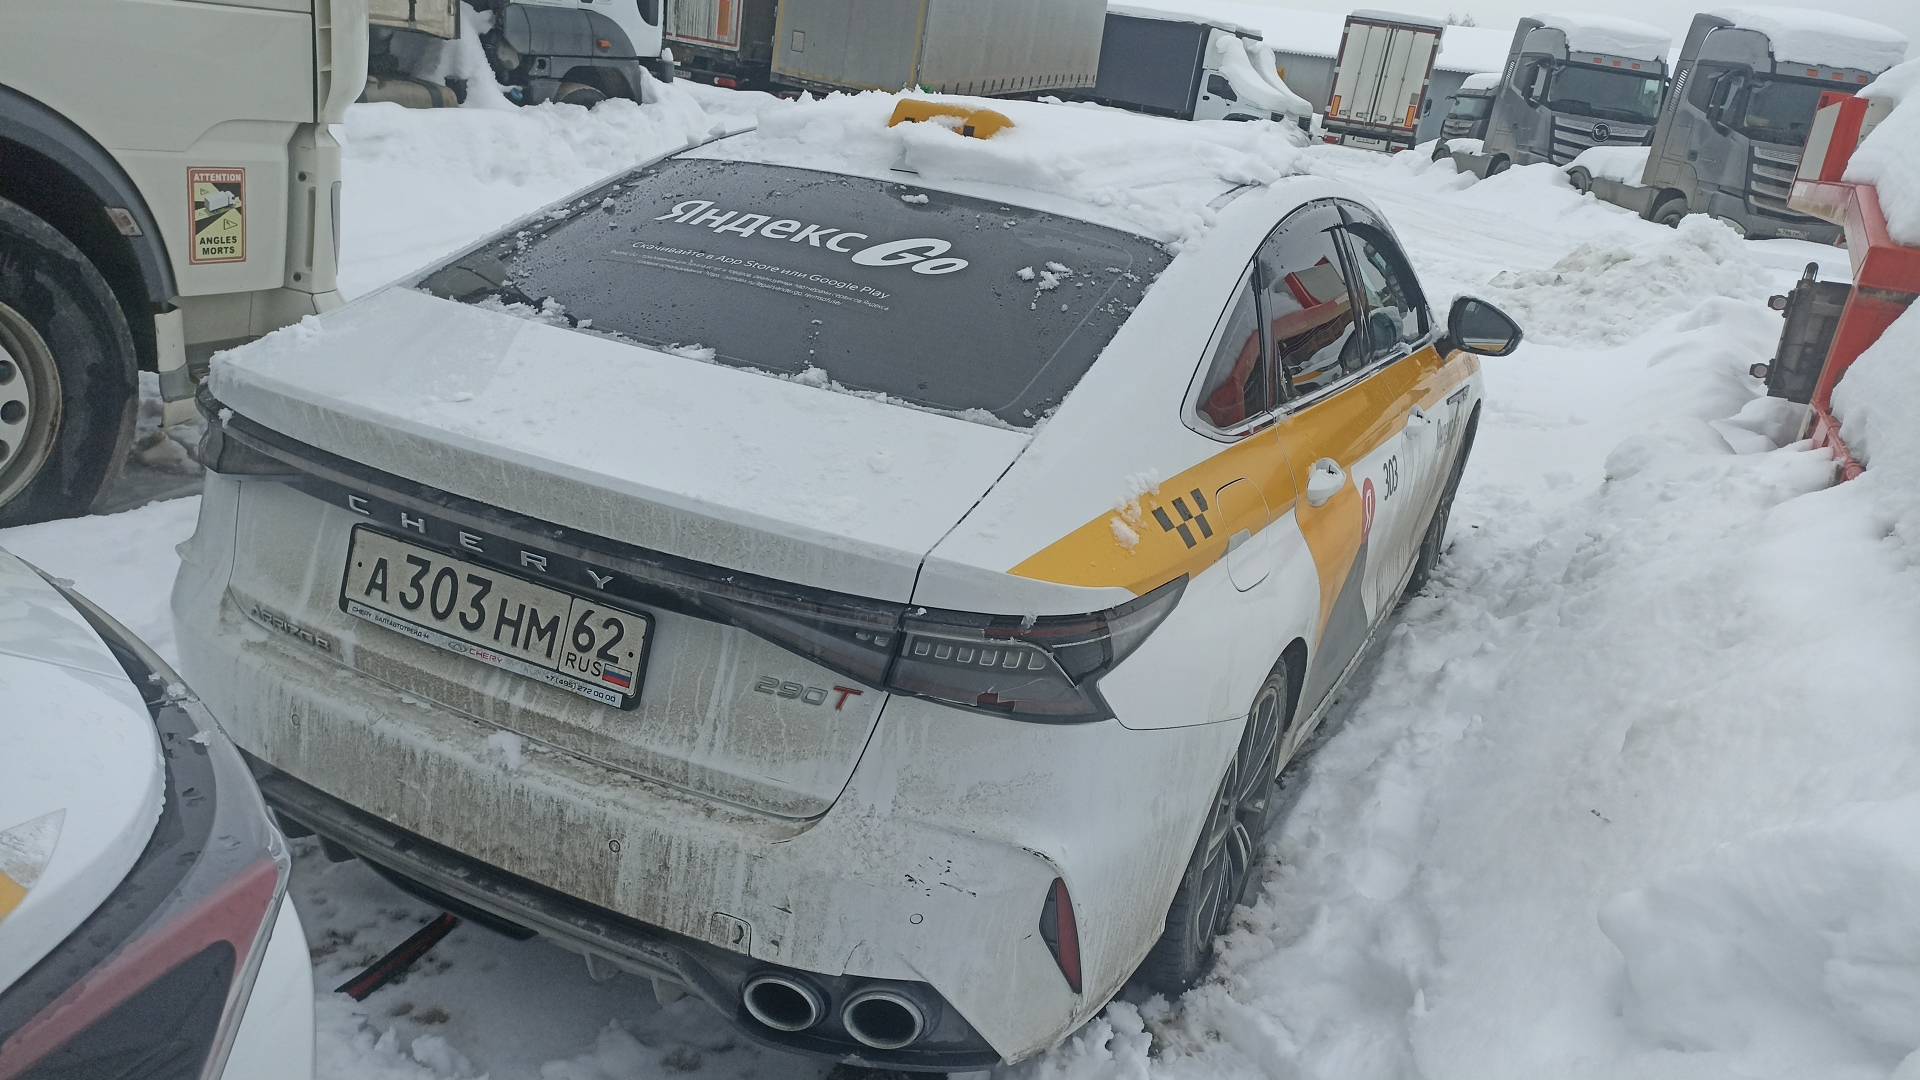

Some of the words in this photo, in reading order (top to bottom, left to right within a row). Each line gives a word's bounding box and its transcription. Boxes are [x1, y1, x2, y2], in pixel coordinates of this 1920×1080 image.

[193, 173, 242, 182] ATTENTION
[199, 235, 238, 245] ANGLES
[202, 245, 236, 255] MORTS
[654, 200, 868, 253] Яндекс
[851, 237, 969, 275] Go
[632, 241, 705, 258] Скачивайте
[715, 255, 743, 265] App
[743, 260, 779, 272] Store
[780, 269, 808, 279] или
[809, 274, 859, 291] Google
[860, 286, 891, 299] Play
[1383, 454, 1398, 501] 303
[348, 494, 614, 590] CHERY
[571, 609, 625, 664] 62
[469, 648, 503, 664] CHERY
[565, 652, 602, 677] RUS
[577, 685, 593, 695] 272
[593, 690, 604, 698] 00
[605, 693, 616, 703] 00
